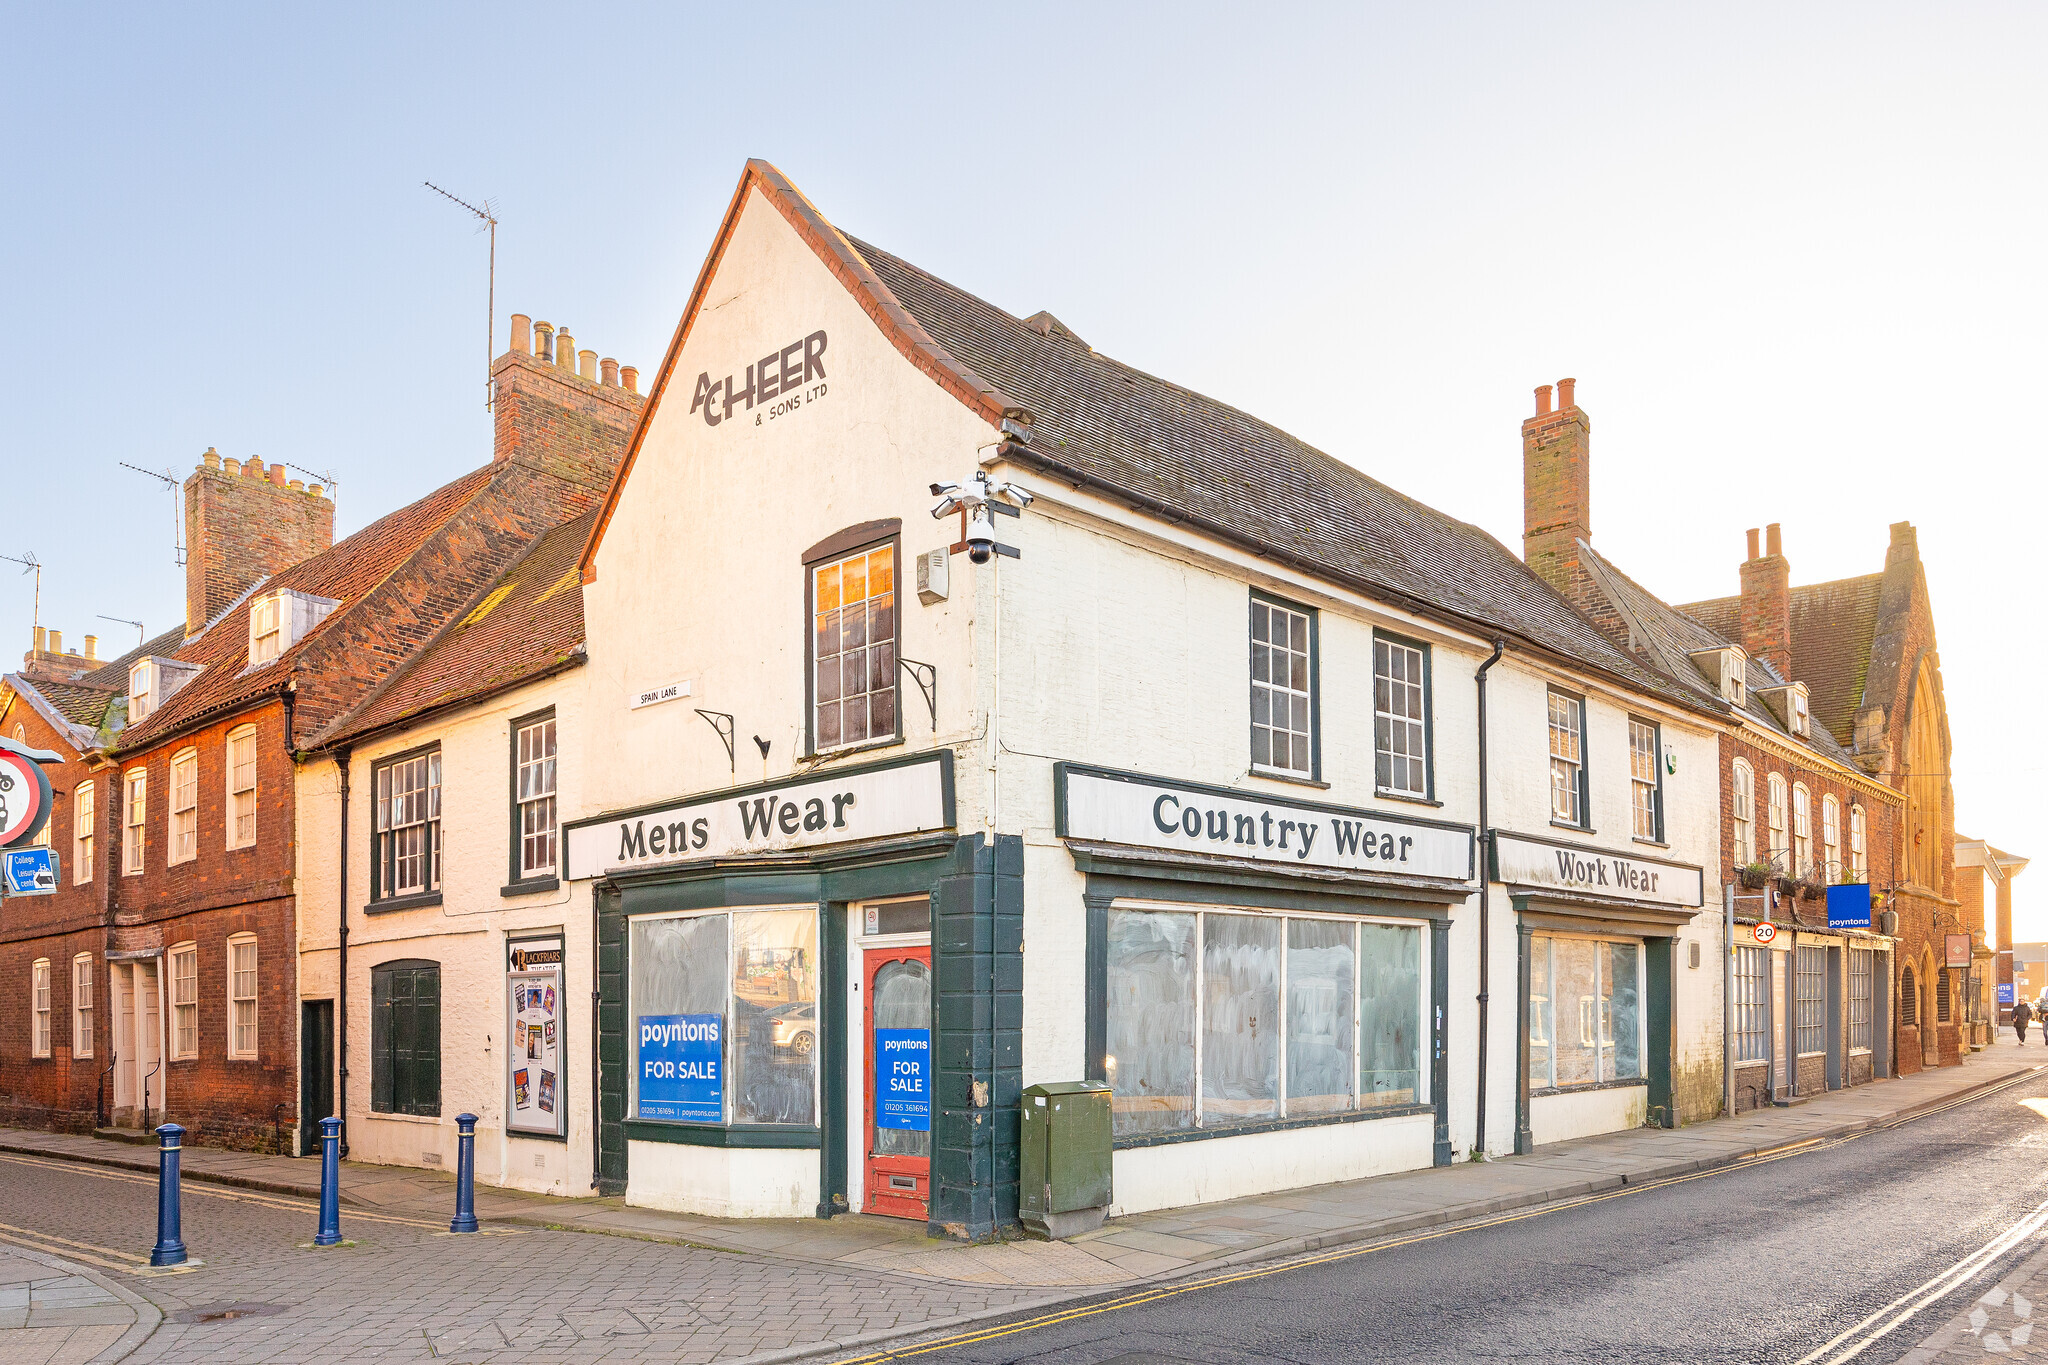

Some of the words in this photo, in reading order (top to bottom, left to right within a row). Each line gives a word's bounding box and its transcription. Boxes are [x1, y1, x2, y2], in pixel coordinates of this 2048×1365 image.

[755, 413, 762, 426] &
[769, 395, 801, 420] SONS
[806, 383, 828, 404] LTD
[640, 691, 658, 704] SPAIN
[661, 686, 677, 699] LANE
[617, 815, 710, 861] Mens
[737, 792, 855, 841] Wear
[1152, 794, 1319, 859] Country
[1330, 817, 1414, 862] Wear
[14, 856, 35, 865] College
[1555, 850, 1609, 886] Work
[1613, 860, 1659, 892] Wear
[20, 879, 34, 888] centr
[1829, 918, 1869, 927] poyntons
[1757, 928, 1773, 937] 20
[516, 949, 561, 971] BLACKFRIARS
[641, 1020, 719, 1048] poyntons
[885, 1039, 928, 1051] poyntons
[645, 1061, 675, 1079] FOR
[678, 1061, 717, 1080] SALE
[893, 1061, 920, 1076] FOR
[890, 1078, 923, 1093] SALE
[657, 1107, 675, 1115] 361694
[885, 1103, 903, 1111] 01205
[905, 1104, 928, 1113] 361694
